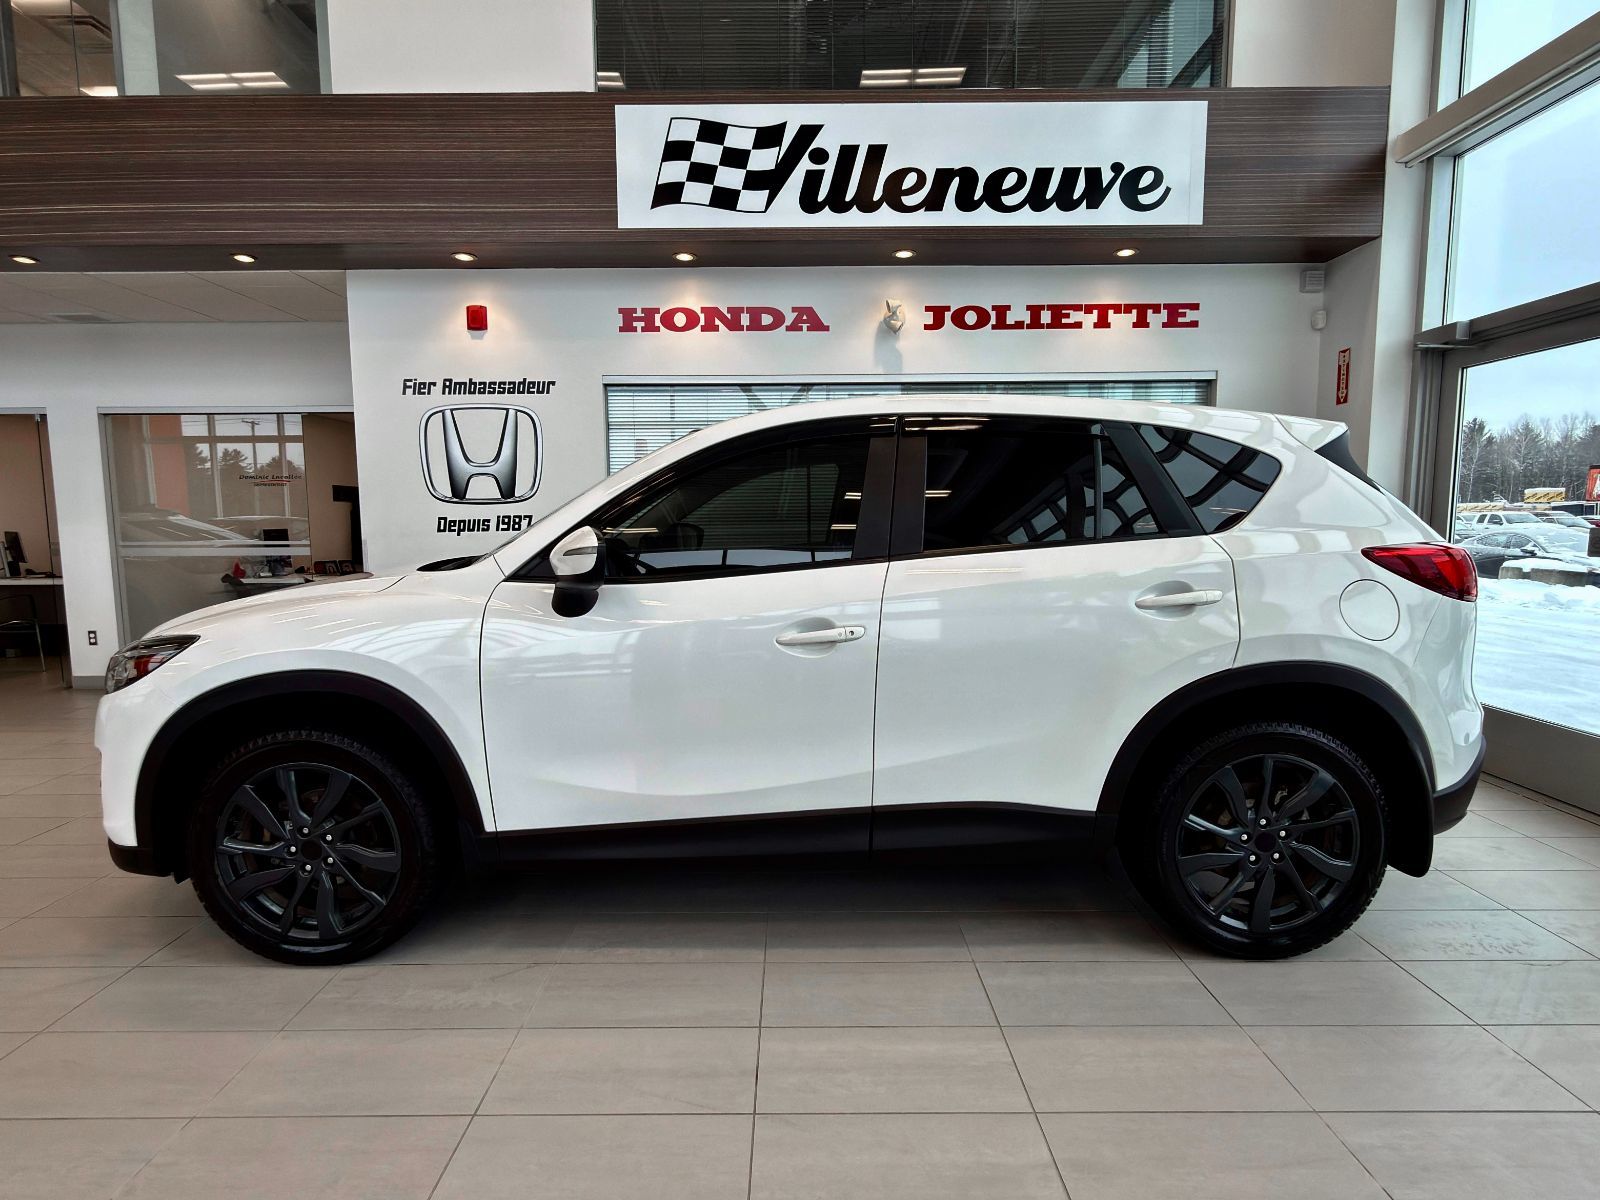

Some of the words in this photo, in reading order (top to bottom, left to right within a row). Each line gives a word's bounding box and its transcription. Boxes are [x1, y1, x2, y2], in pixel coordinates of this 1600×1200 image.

[651, 117, 1172, 215] Villeneuve
[618, 305, 830, 333] HONDA
[923, 302, 1200, 331] JOLIETTE
[402, 378, 437, 396] Fier
[441, 378, 557, 396] Ambassadeur
[436, 516, 492, 537] Depuis
[495, 514, 534, 532] 1987
